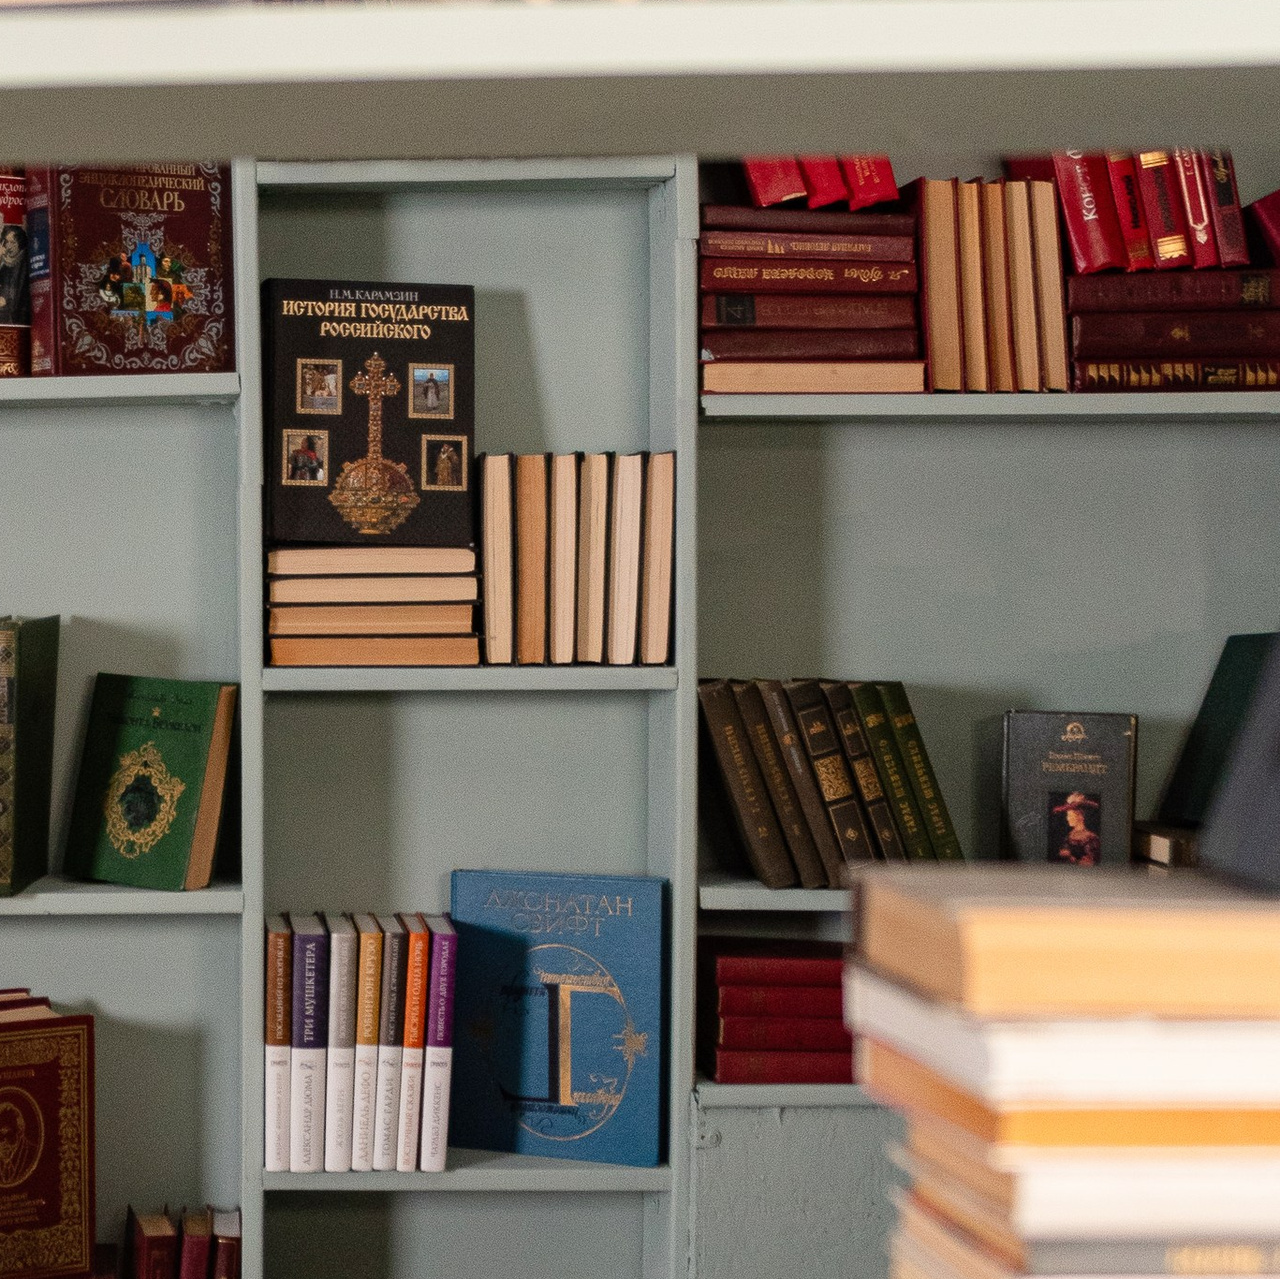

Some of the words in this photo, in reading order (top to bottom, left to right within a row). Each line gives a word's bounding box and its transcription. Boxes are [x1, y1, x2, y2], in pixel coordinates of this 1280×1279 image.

[77, 171, 205, 192] ЭНЦИКЛОПЕДИЧЕСКИЙ
[99, 191, 186, 212] СЛОВАРЬ
[282, 300, 356, 318] ИСТОРИЯ
[360, 303, 469, 323] ГОСУДАРСТВА
[320, 320, 432, 340] РОССИЙСКОГО
[484, 888, 633, 917] ДЖОНАТАН
[513, 913, 605, 937] СВИФТ
[365, 939, 376, 974] КРУЗО
[304, 941, 317, 1015] МУШКЕТЕРА
[363, 976, 374, 1038] РОБИНЗОН
[303, 1018, 316, 1042] ТРИ
[303, 1073, 314, 1106] ДЮМА
[360, 1071, 372, 1103] ДЕФО
[384, 1076, 393, 1114] ГАРДИ
[432, 1081, 441, 1124] ДИККЕНС
[302, 1108, 313, 1166] АЛЕКСАНДР
[358, 1105, 369, 1162] ДАНИЕЛЬ
[382, 1117, 391, 1156] ТОМАС
